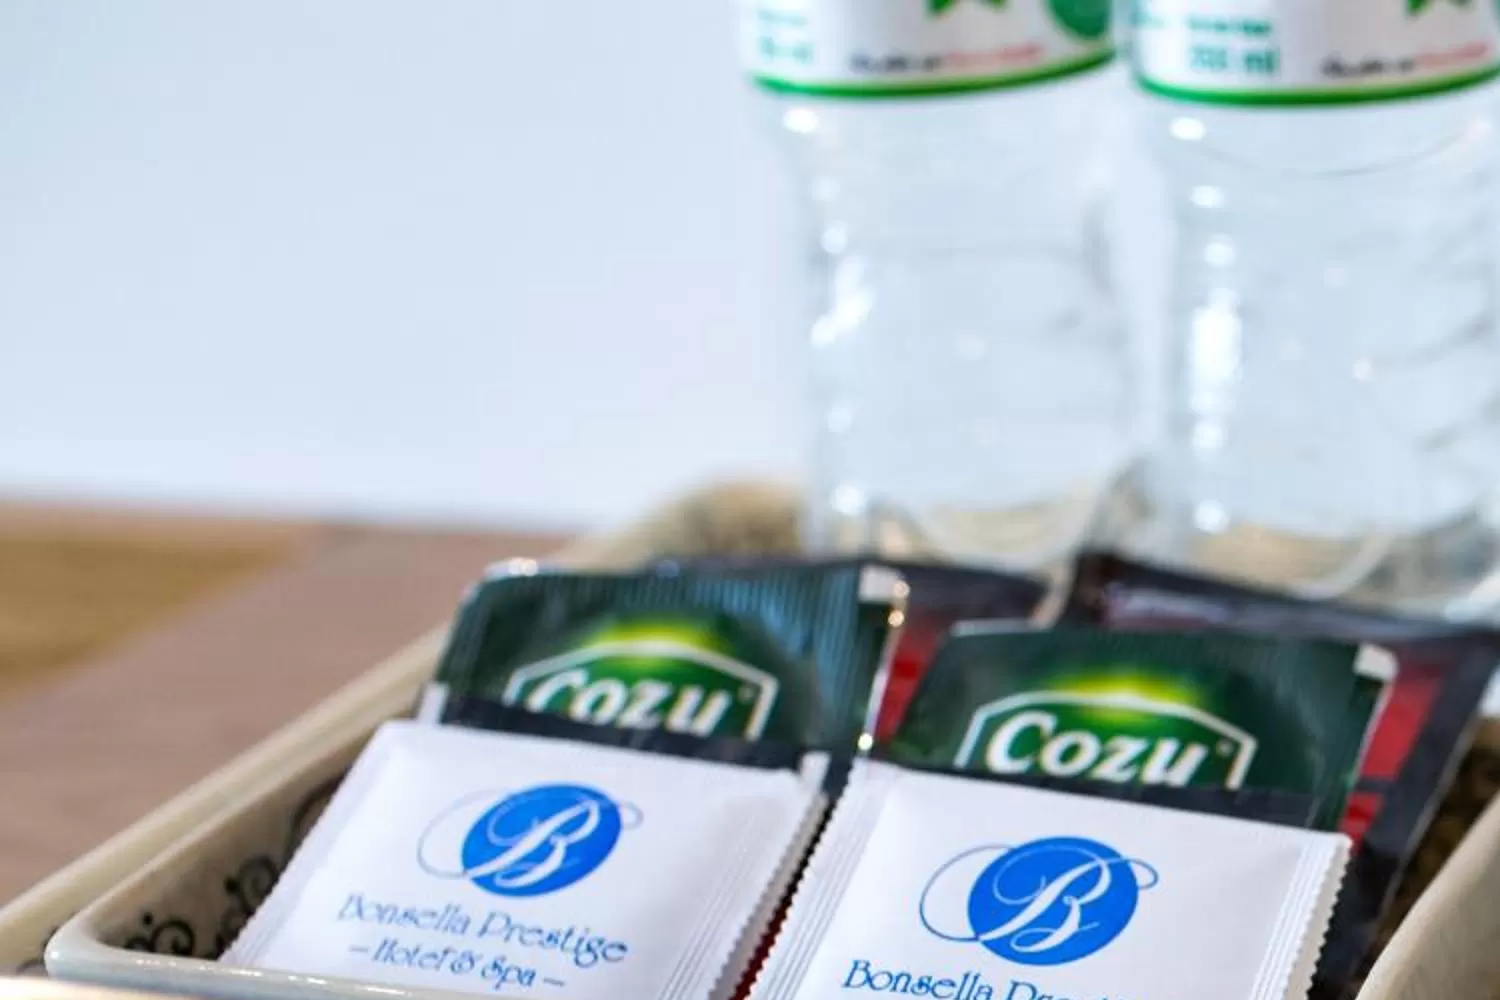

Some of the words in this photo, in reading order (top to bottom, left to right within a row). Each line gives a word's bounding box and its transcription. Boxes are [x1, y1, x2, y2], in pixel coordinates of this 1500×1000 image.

[986, 709, 1208, 787] Cozu
[337, 891, 472, 936] Bonsella
[477, 910, 629, 969] Prestige
[371, 937, 452, 971] Hotel
[480, 955, 537, 989] Spa
